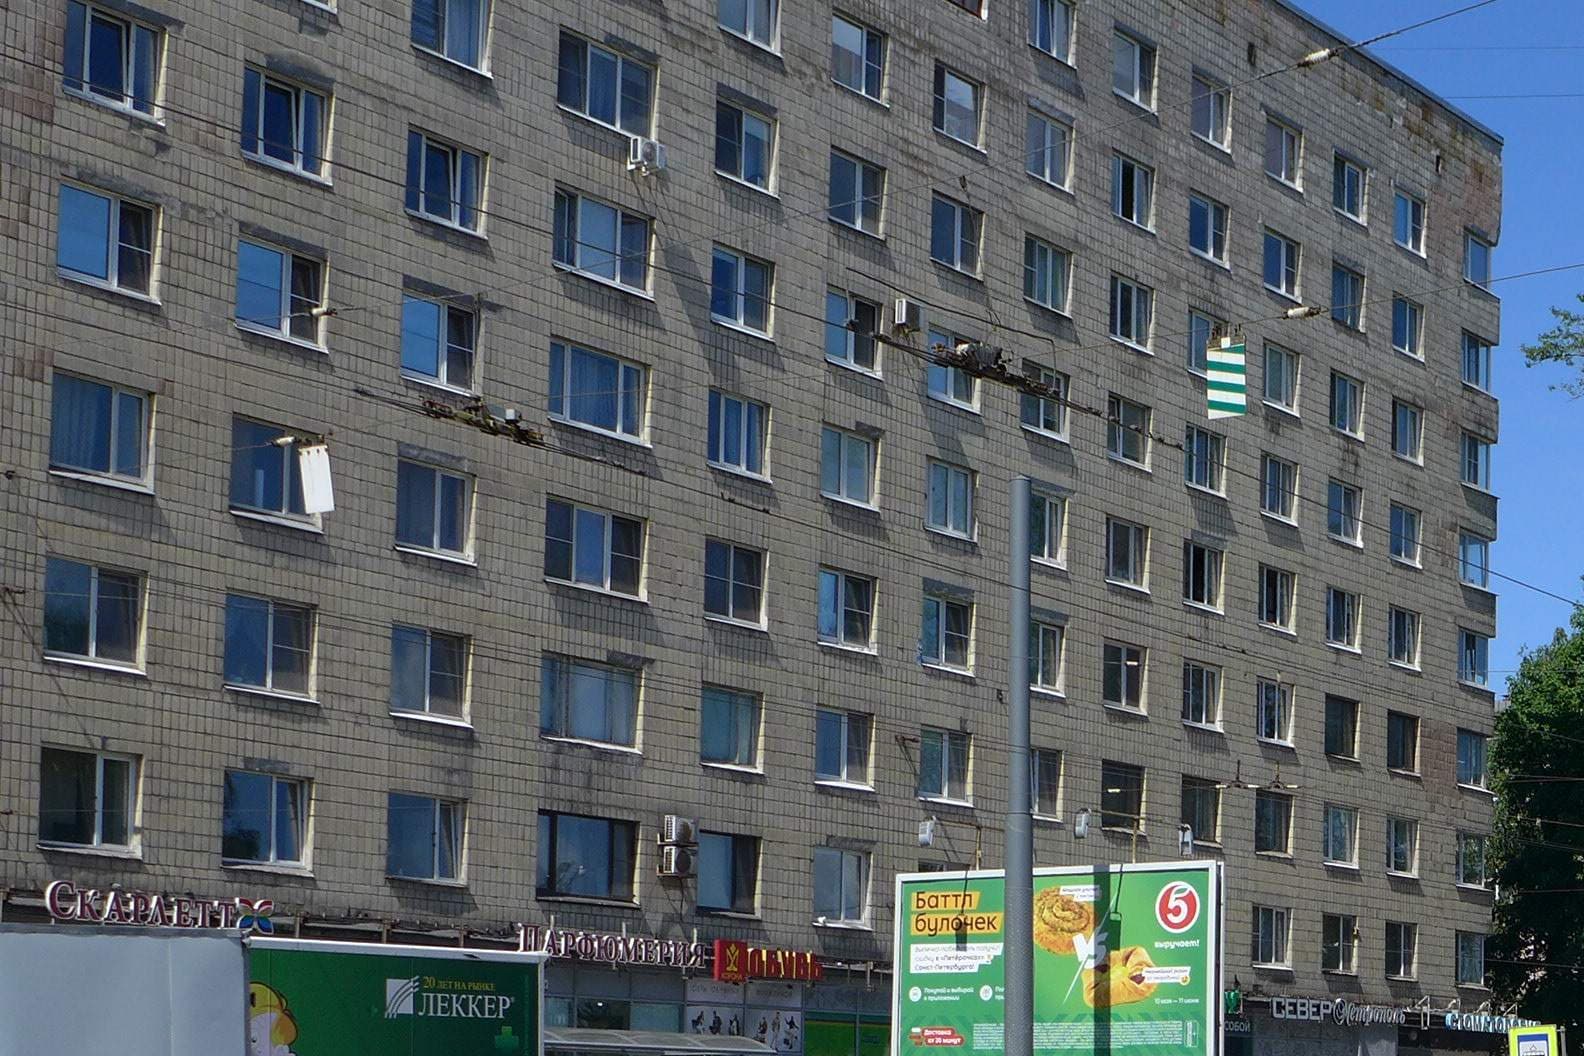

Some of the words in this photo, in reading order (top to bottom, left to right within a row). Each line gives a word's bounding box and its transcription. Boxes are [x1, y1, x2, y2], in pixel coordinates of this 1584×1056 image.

[46, 880, 240, 929] СКАРЛЕТТ
[915, 891, 973, 909] Баттл
[914, 912, 998, 937] булочек
[517, 923, 707, 968] ПАРФЮМЕРИЯ
[746, 948, 823, 980] ОБУВЬ
[423, 976, 437, 988] 20
[437, 981, 453, 990] ЛЕТ
[454, 981, 467, 990] НА
[468, 982, 496, 991] РЫНКЕ
[418, 992, 511, 1019] ЛЕККЕР
[1271, 997, 1334, 1021] СЕВЕР
